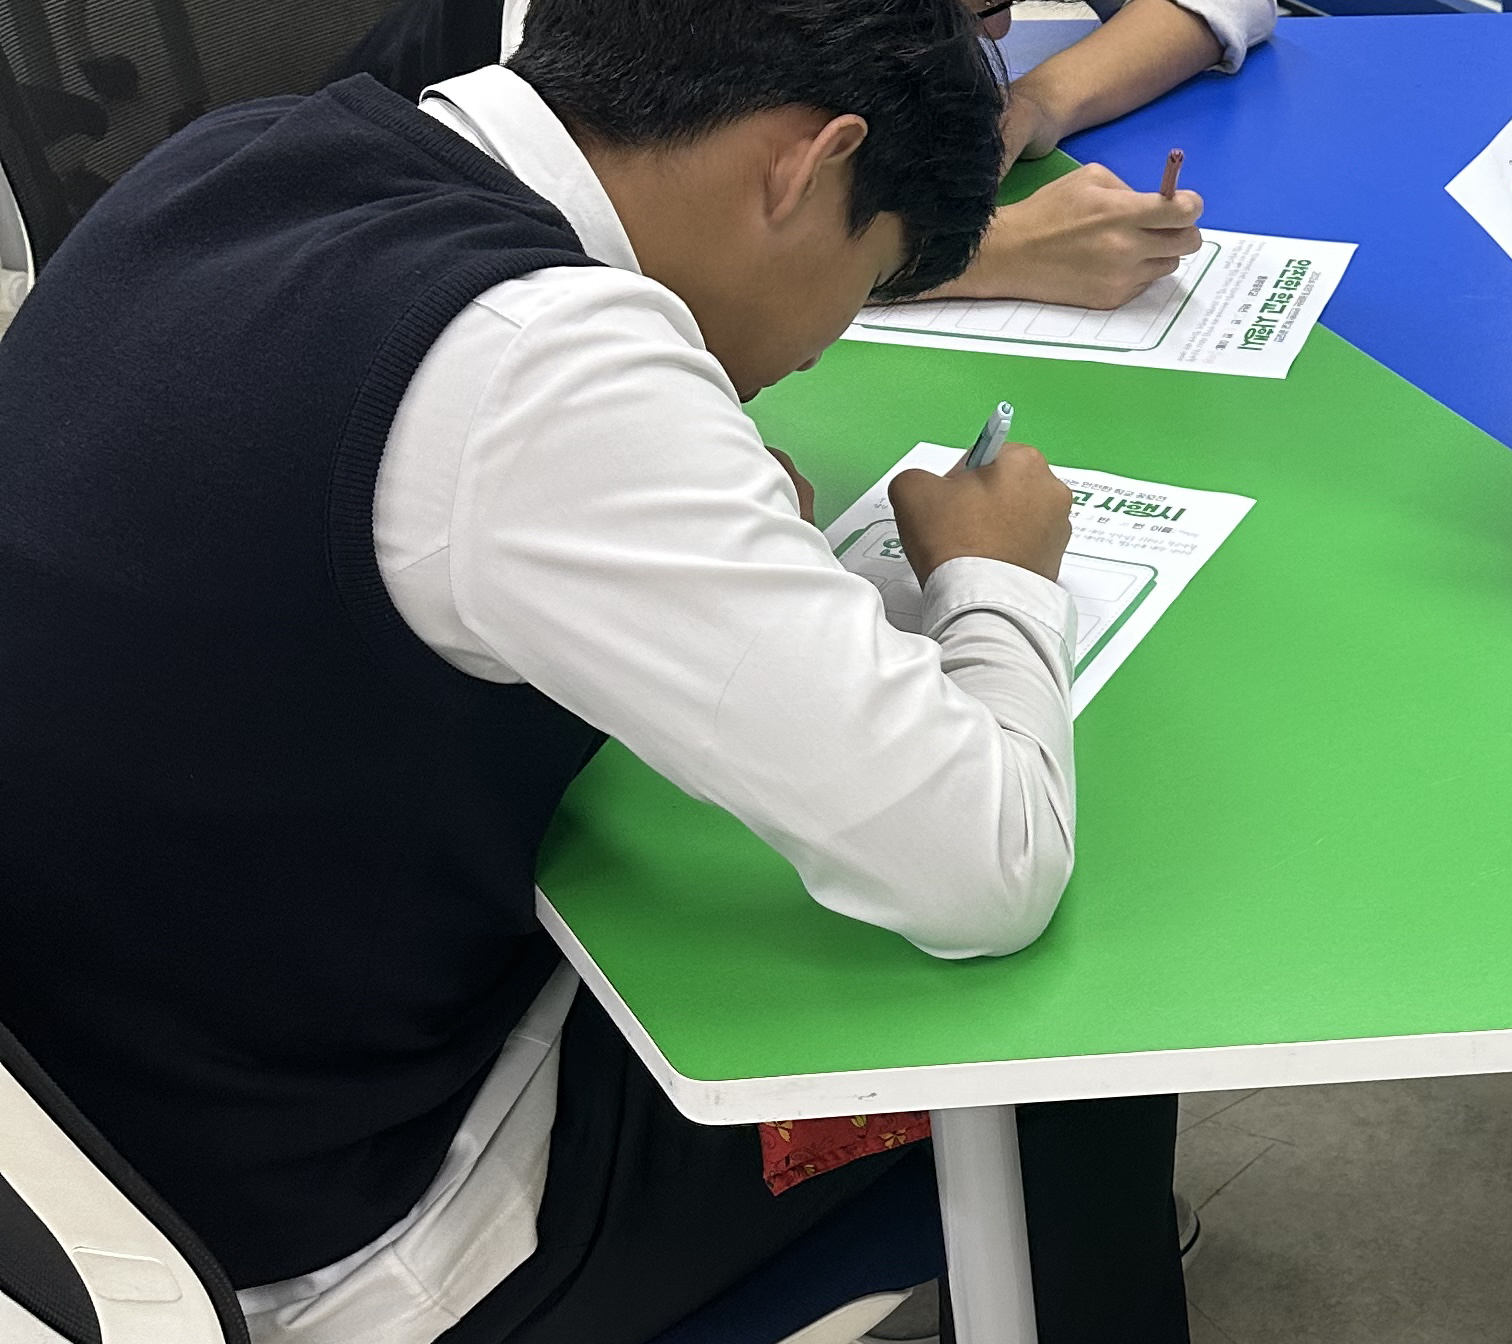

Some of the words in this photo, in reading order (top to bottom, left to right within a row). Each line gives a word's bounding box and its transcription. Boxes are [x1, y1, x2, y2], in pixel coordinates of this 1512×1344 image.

[1273, 259, 1311, 290] 안전한
[1259, 293, 1293, 313] 학교
[1238, 316, 1278, 350] 사행시
[1071, 489, 1094, 506] 교
[1094, 497, 1187, 521] 사행시
[1097, 516, 1111, 524] 반
